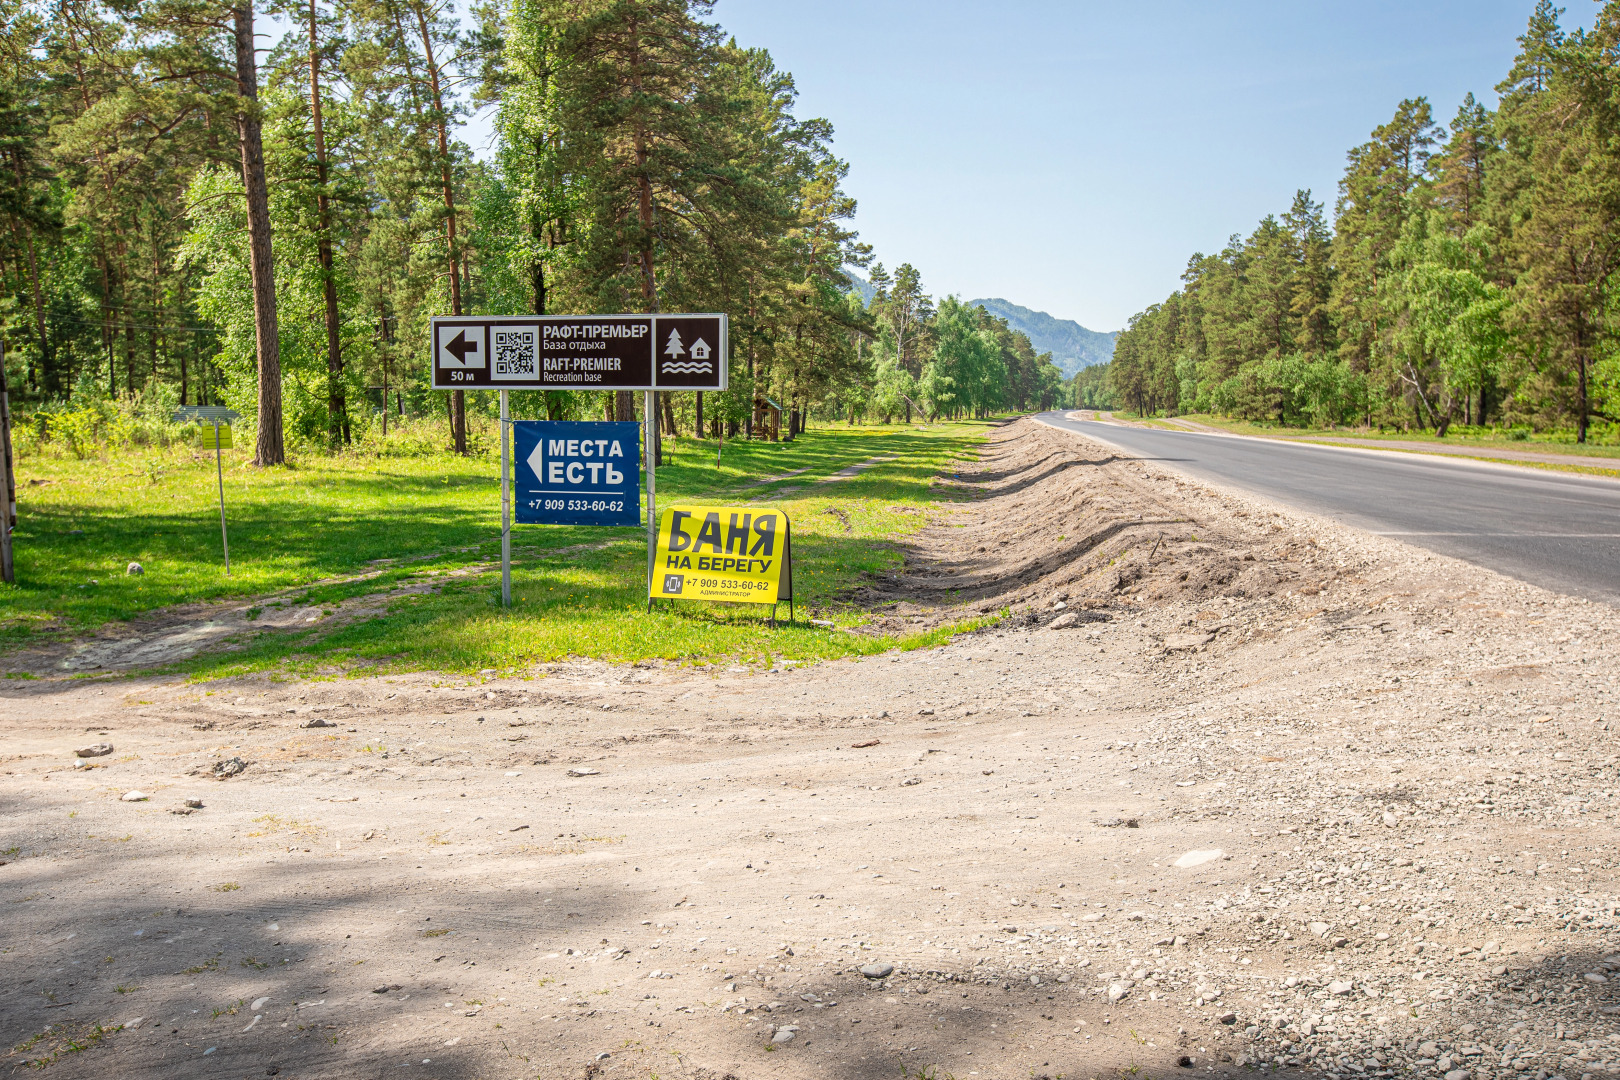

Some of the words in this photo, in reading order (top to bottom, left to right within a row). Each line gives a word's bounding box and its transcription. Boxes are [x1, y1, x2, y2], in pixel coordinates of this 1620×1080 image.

[543, 325, 649, 338] РАФТ-ПРЕМЬЕР
[543, 340, 568, 350] База
[569, 341, 606, 351] отдыха
[543, 358, 622, 371] RAFT-PREMIER
[450, 371, 464, 381] 50
[543, 372, 582, 382] Recreation
[584, 372, 602, 382] base
[549, 440, 624, 457] МЕСТА
[549, 462, 624, 484] ЕСТЬ
[528, 499, 542, 509] +7
[544, 499, 565, 510] 909
[567, 500, 624, 511] 533-60-62
[668, 510, 777, 557] БАНЯ
[666, 555, 692, 570] НА
[697, 556, 773, 573] БЕРЕГУ
[685, 578, 698, 587] +7
[700, 578, 718, 588] 909
[720, 579, 769, 591] 533-60-62
